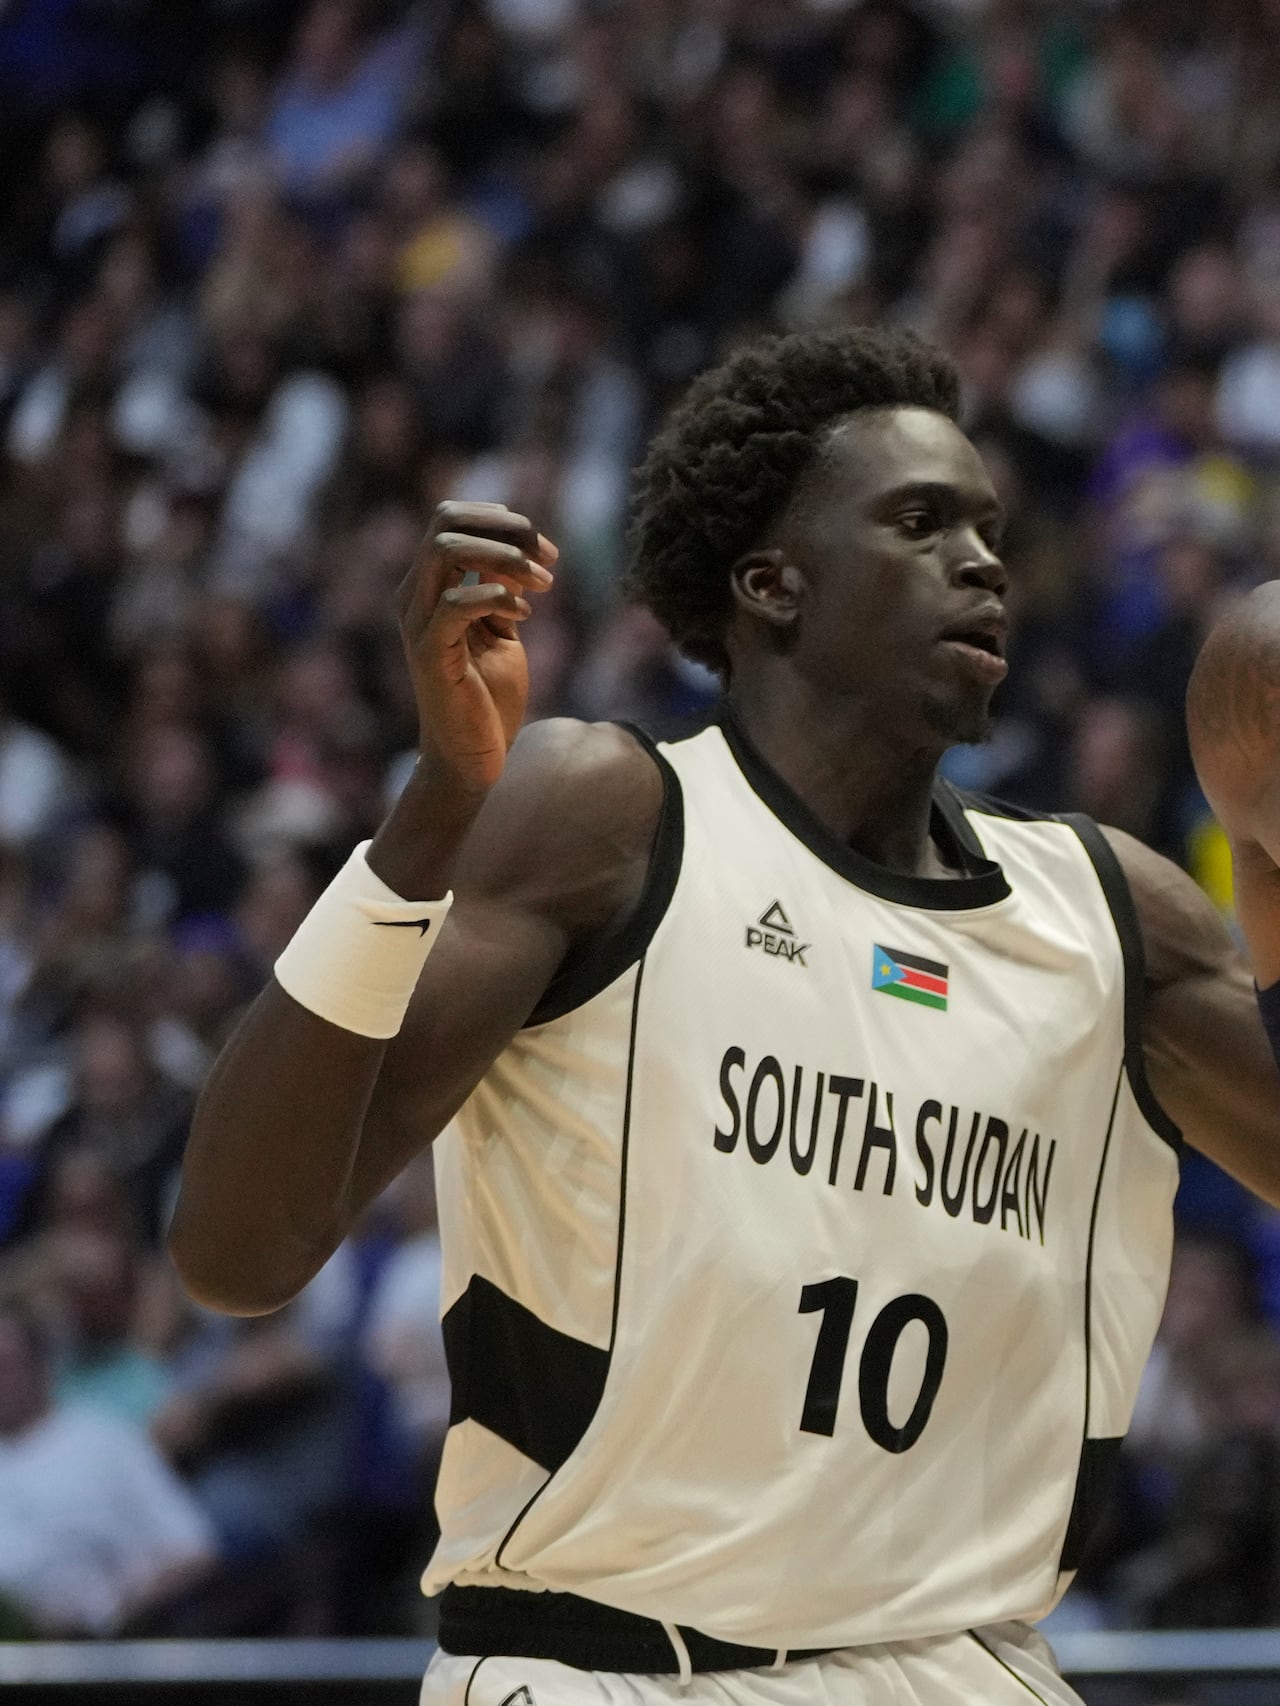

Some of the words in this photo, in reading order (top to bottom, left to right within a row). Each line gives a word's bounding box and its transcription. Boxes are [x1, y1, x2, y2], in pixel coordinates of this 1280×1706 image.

[745, 926, 811, 968] PEAK
[713, 1045, 899, 1196] SOUTH
[914, 1098, 1056, 1246] SUDAN
[797, 1275, 949, 1455] 10
